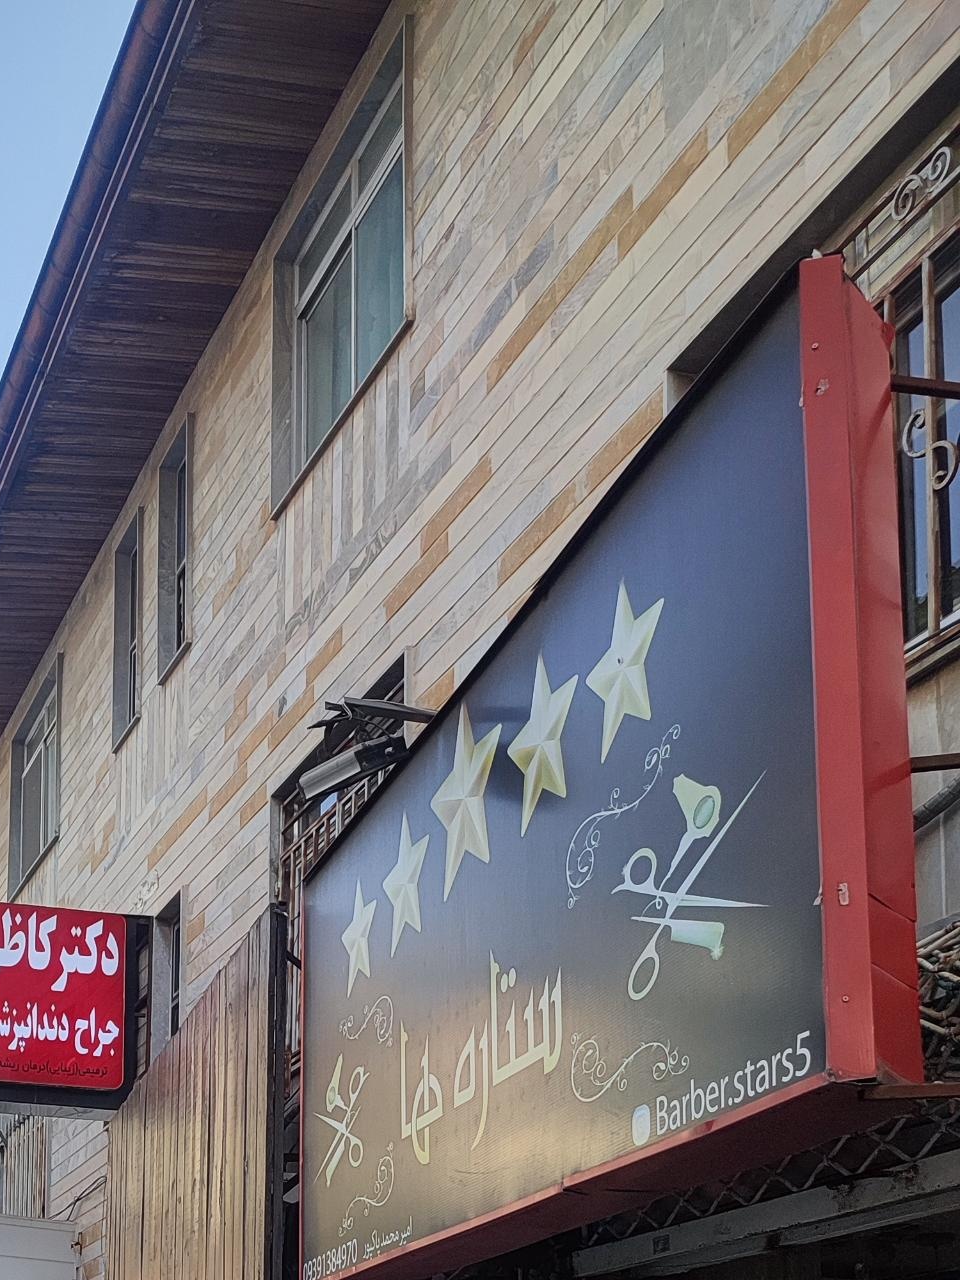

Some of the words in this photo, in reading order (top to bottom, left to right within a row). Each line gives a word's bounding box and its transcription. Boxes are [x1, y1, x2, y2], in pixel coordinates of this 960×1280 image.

[50, 919, 120, 992] دکتر
[74, 1007, 120, 1057] جراح
[654, 1030, 812, 1136] Barber.stars5
